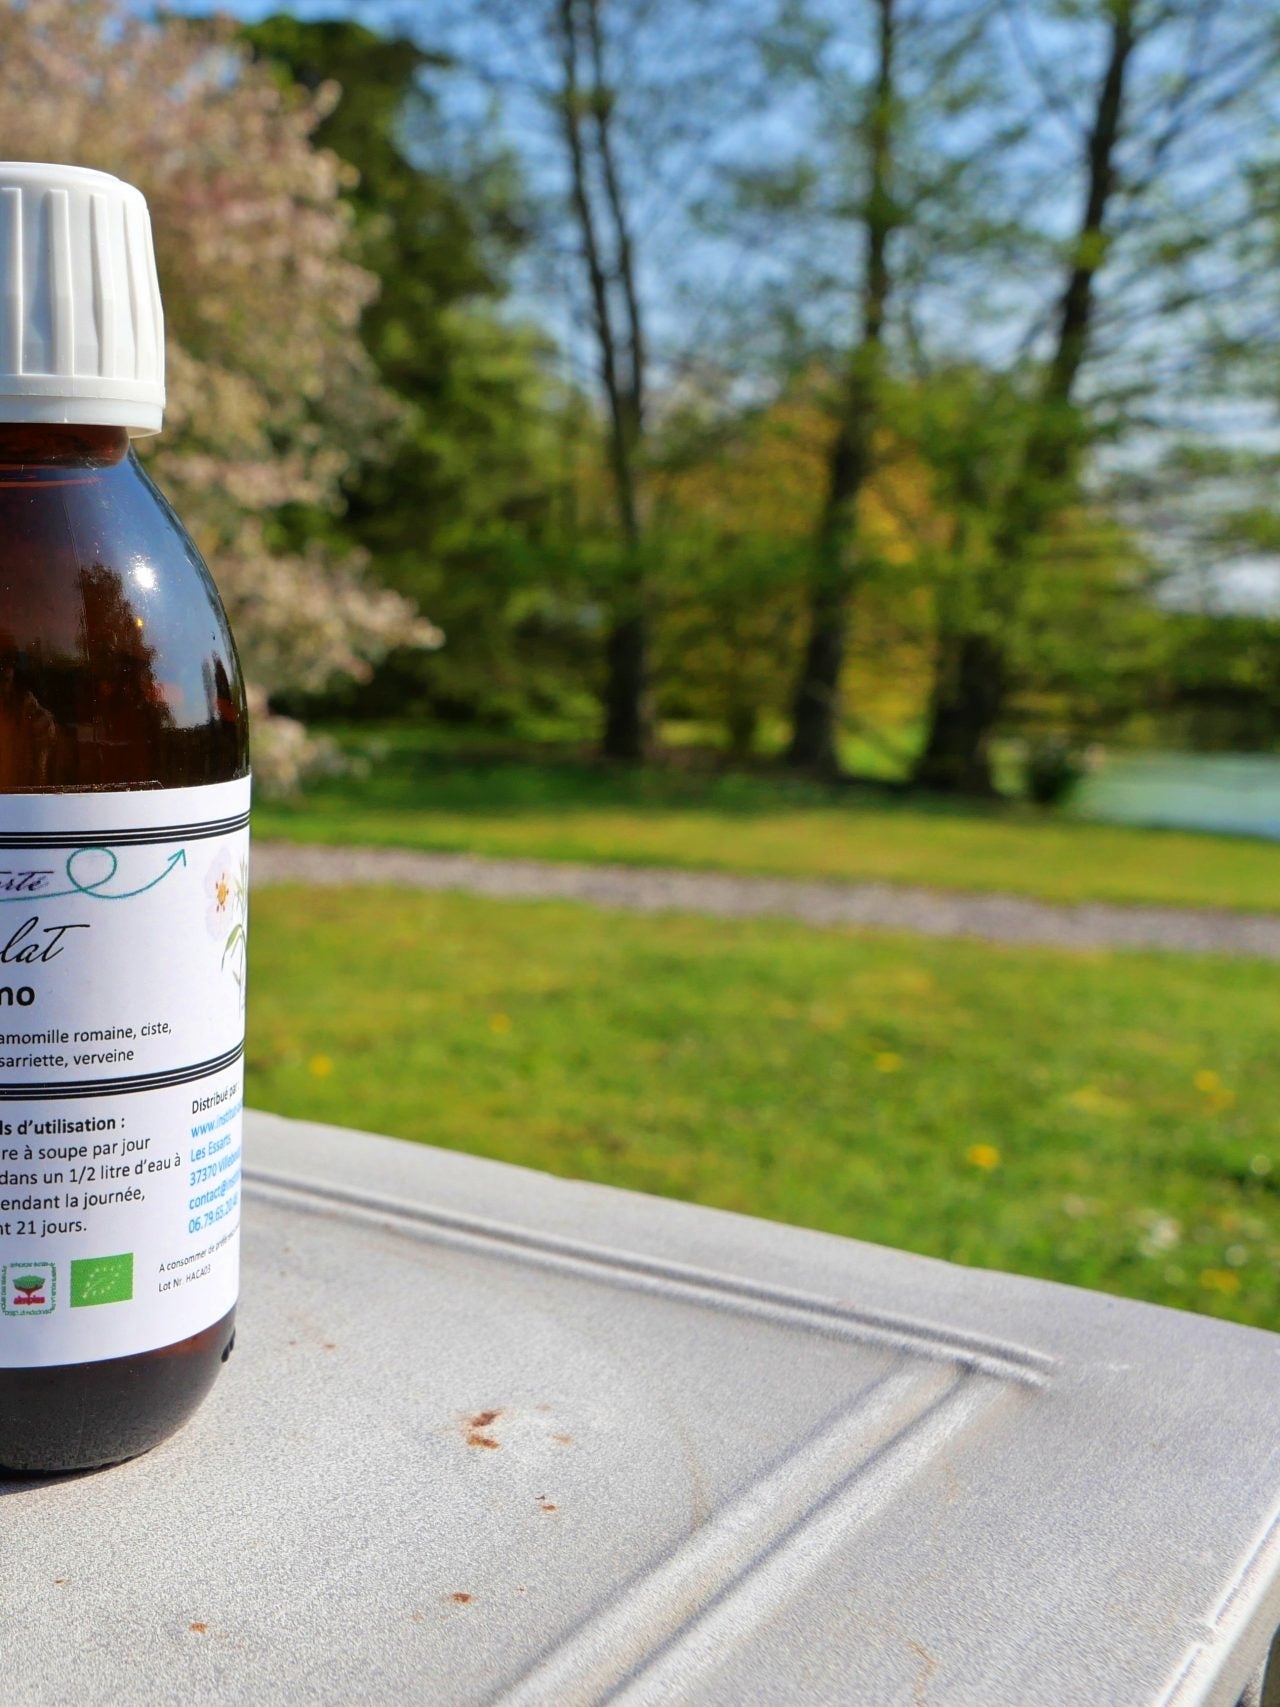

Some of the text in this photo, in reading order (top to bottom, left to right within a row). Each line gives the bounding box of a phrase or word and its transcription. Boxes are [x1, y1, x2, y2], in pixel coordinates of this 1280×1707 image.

[73, 1026, 137, 1043] romaine,
[140, 1020, 172, 1037] ciste,
[73, 1048, 135, 1066] verveine
[191, 1086, 228, 1115] Distribué
[17, 1117, 116, 1135] d’utilisation
[23, 1144, 33, 1160] à
[38, 1146, 88, 1162] soupe
[92, 1142, 118, 1159] par
[121, 1137, 151, 1156] jour
[191, 1146, 206, 1162] Les
[43, 1171, 64, 1184] un
[69, 1165, 96, 1185] 1/2
[100, 1164, 131, 1180] litre
[134, 1158, 171, 1175] d’eau
[174, 1152, 181, 1167] à
[190, 1162, 217, 1186] 37370
[65, 1193, 79, 1208] la
[82, 1186, 145, 1210] journée,
[16, 1220, 37, 1235] 21
[40, 1219, 87, 1238] jours.
[158, 1263, 165, 1274] A
[166, 1248, 207, 1271] consommer
[158, 1281, 171, 1292] Lot
